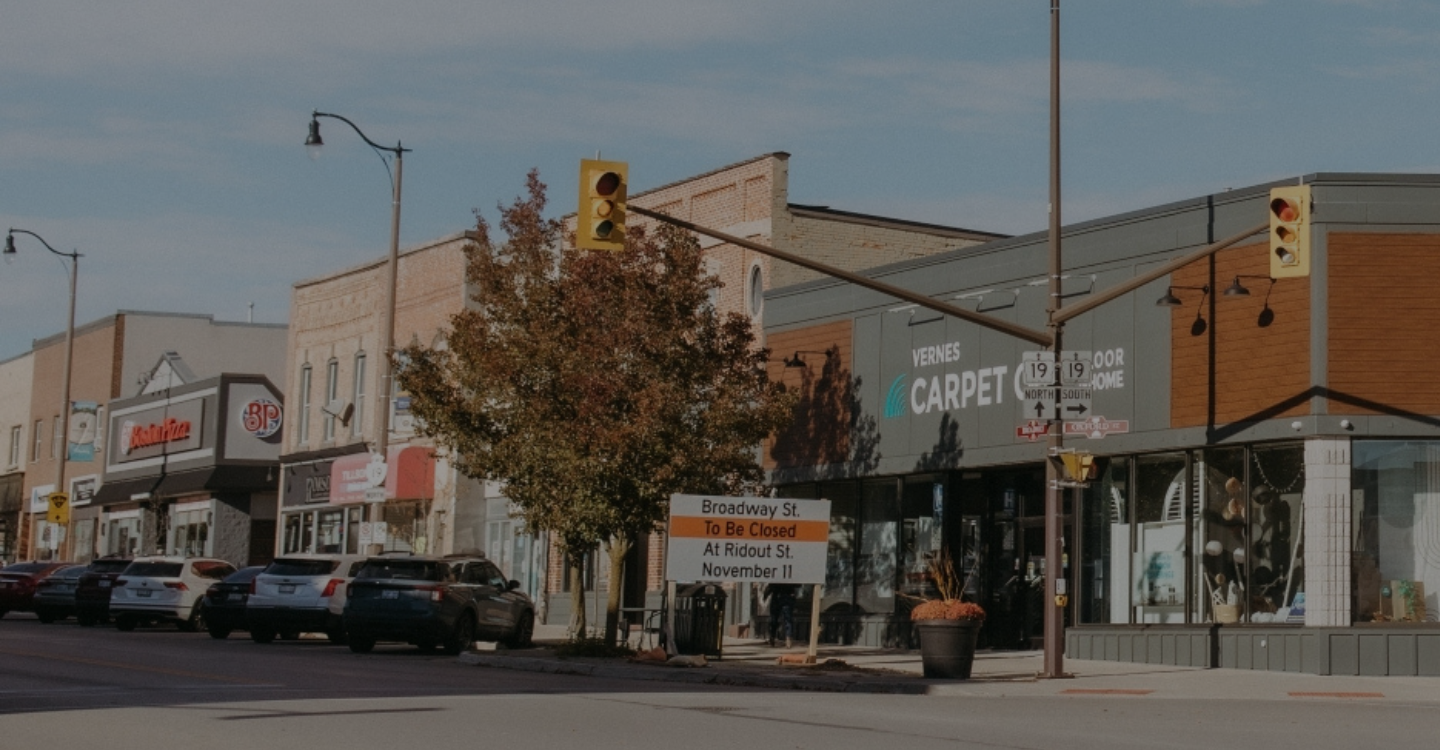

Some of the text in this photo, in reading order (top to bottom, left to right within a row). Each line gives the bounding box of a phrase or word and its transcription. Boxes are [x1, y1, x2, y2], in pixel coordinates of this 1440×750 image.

[912, 341, 961, 368] VERNES
[1031, 362, 1048, 378] 19
[1069, 362, 1084, 378] 19
[910, 365, 1008, 415] CARPET
[1024, 389, 1054, 400] NORTH
[1062, 389, 1091, 400] SOUTH
[244, 401, 280, 432] BP
[1071, 422, 1109, 432] OXFORD
[701, 499, 800, 520] Broadway St.
[704, 520, 797, 538] To Be Closed
[703, 541, 794, 559] At Ridout St.
[701, 562, 793, 579] November 11
